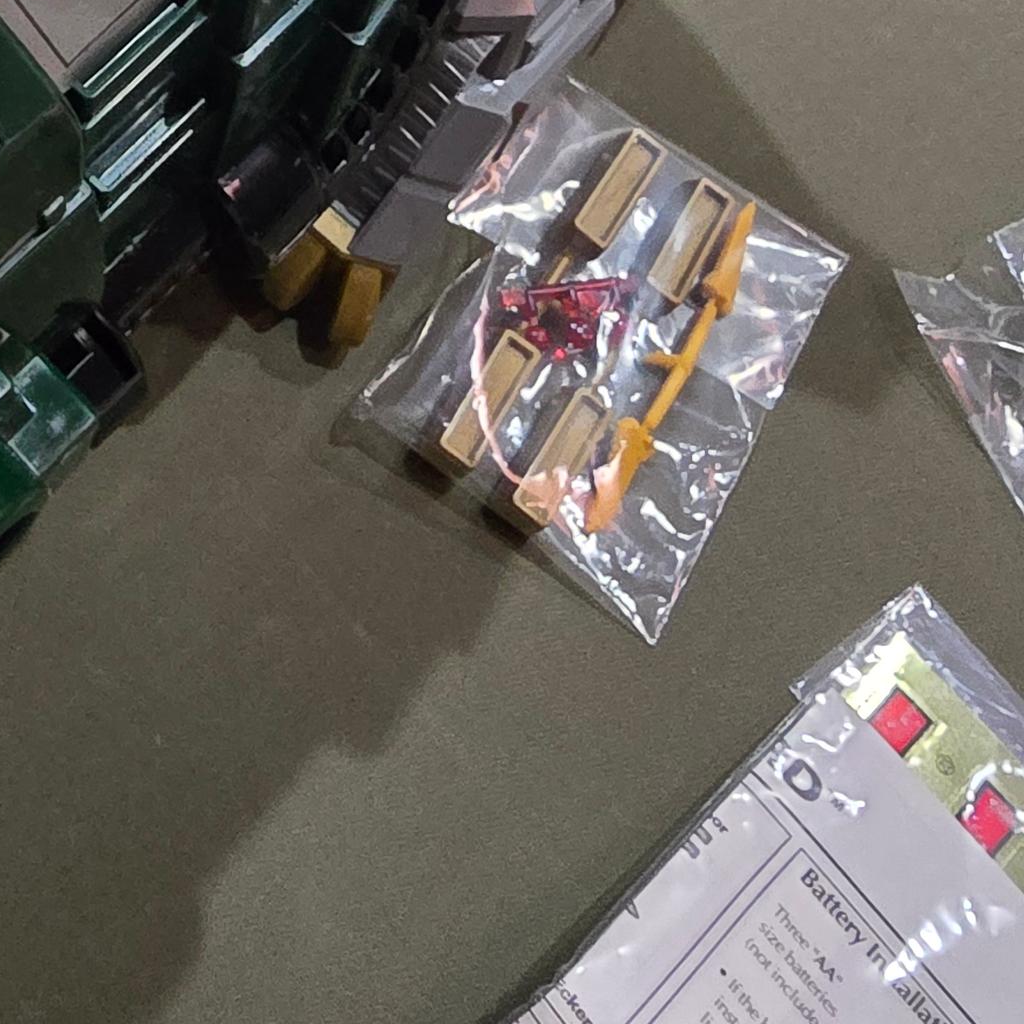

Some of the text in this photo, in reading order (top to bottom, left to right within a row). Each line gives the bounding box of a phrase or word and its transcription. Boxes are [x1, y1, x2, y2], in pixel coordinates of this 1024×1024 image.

[775, 902, 810, 951] Three
[800, 868, 869, 946] Battery
[744, 938, 772, 971] (not
[758, 922, 838, 1018] size batteries
[728, 979, 760, 1021] If the
